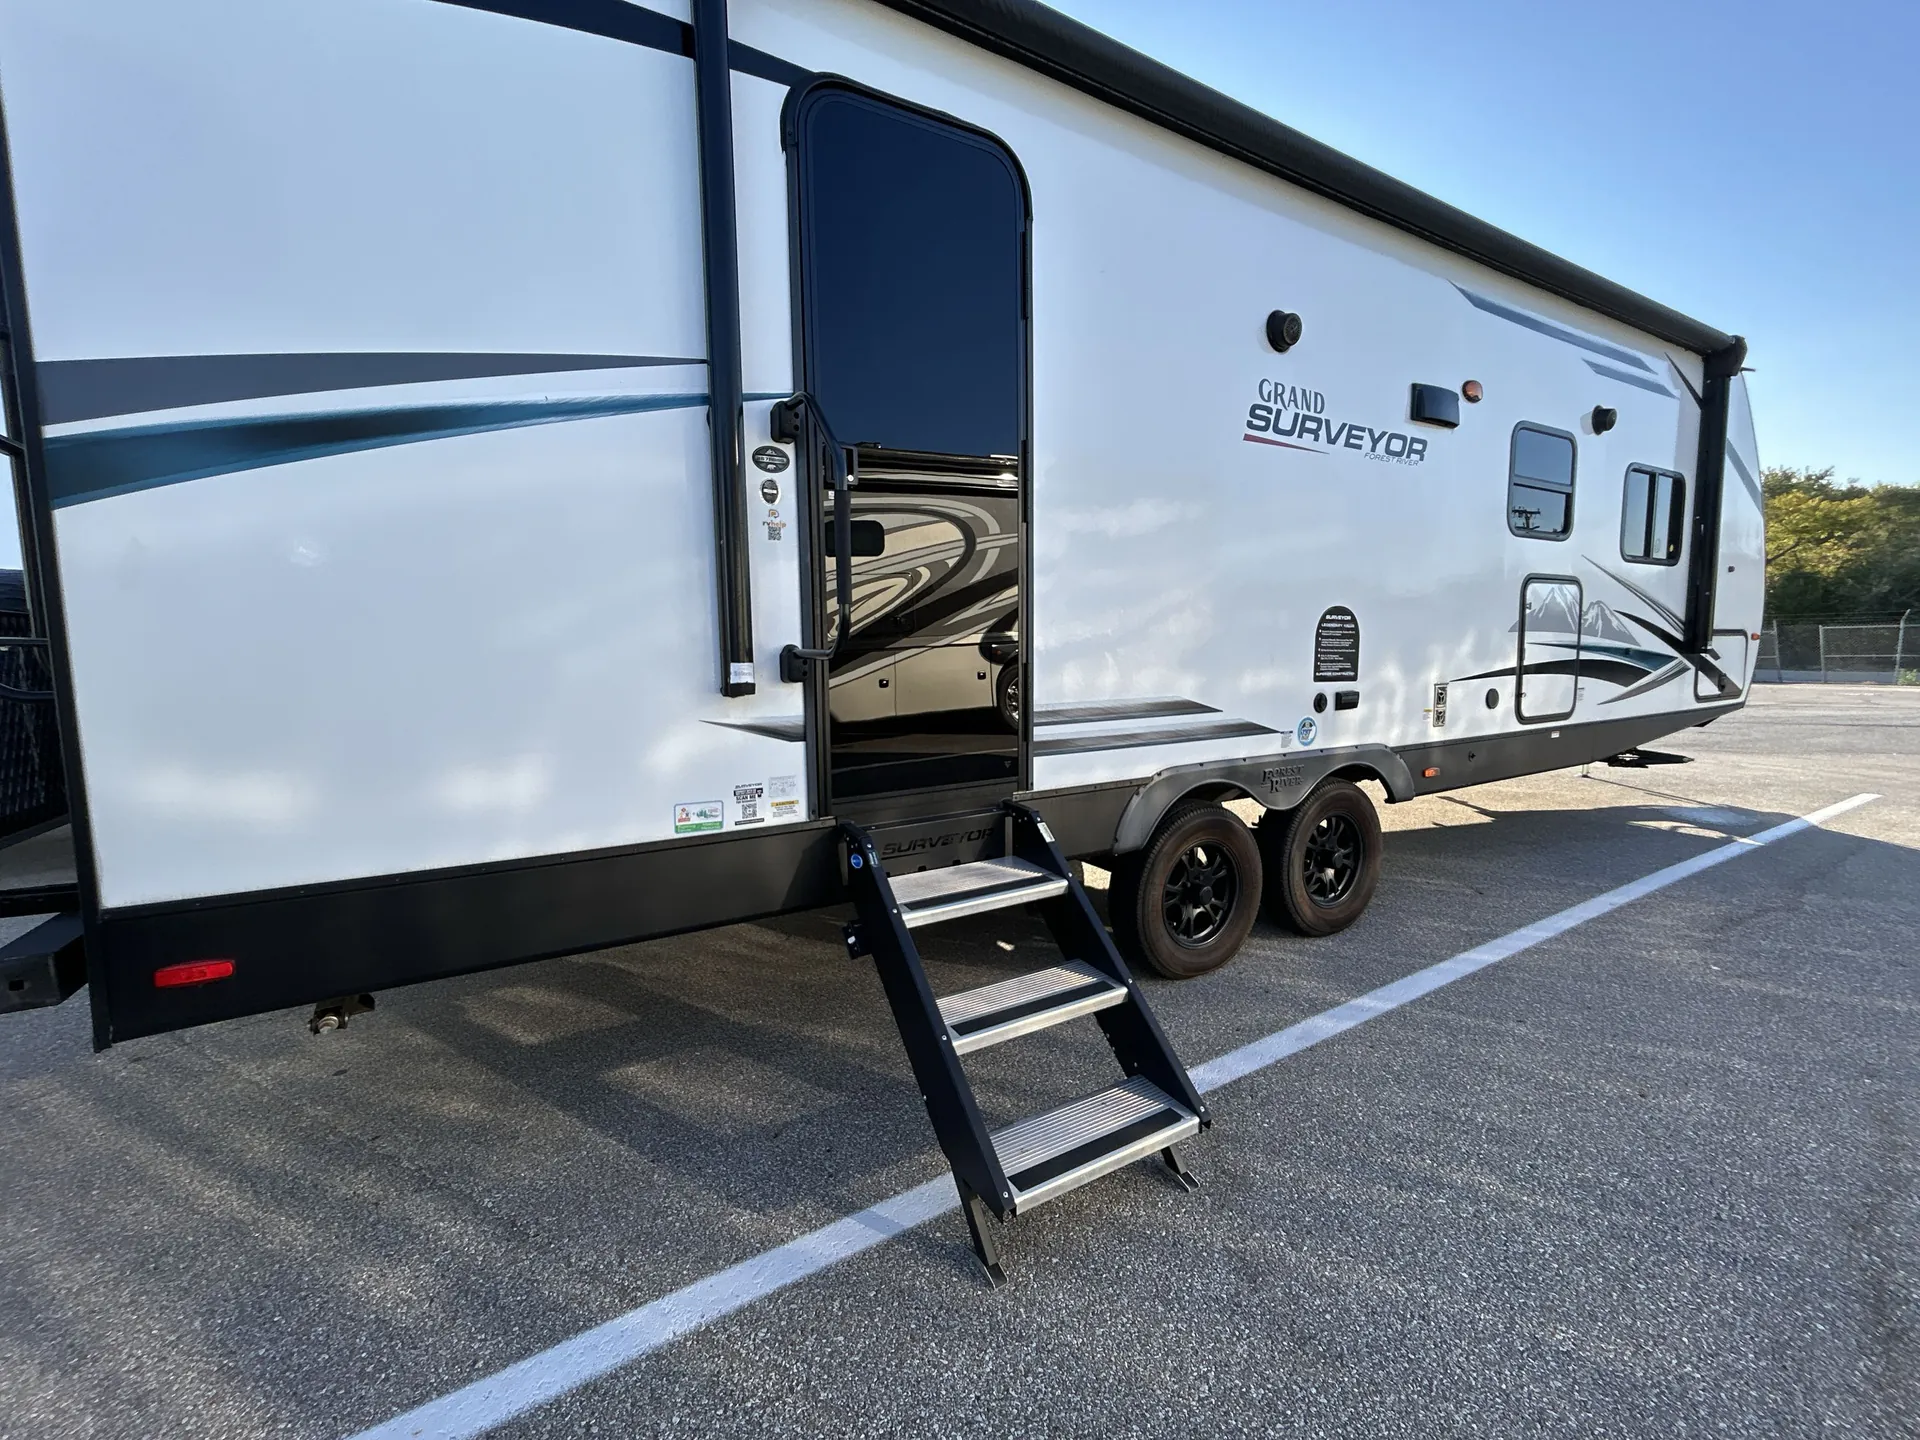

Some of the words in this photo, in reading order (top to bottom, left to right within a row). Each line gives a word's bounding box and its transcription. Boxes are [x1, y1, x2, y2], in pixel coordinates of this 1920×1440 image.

[1258, 378, 1325, 414] GRAND
[1246, 403, 1428, 461] SURVEYOR
[1364, 452, 1396, 463] FOREST
[1396, 457, 1420, 467] RIVER
[1262, 765, 1304, 782] FOREST
[1270, 776, 1303, 793] RIVER
[882, 828, 994, 855] SURVEYOR
